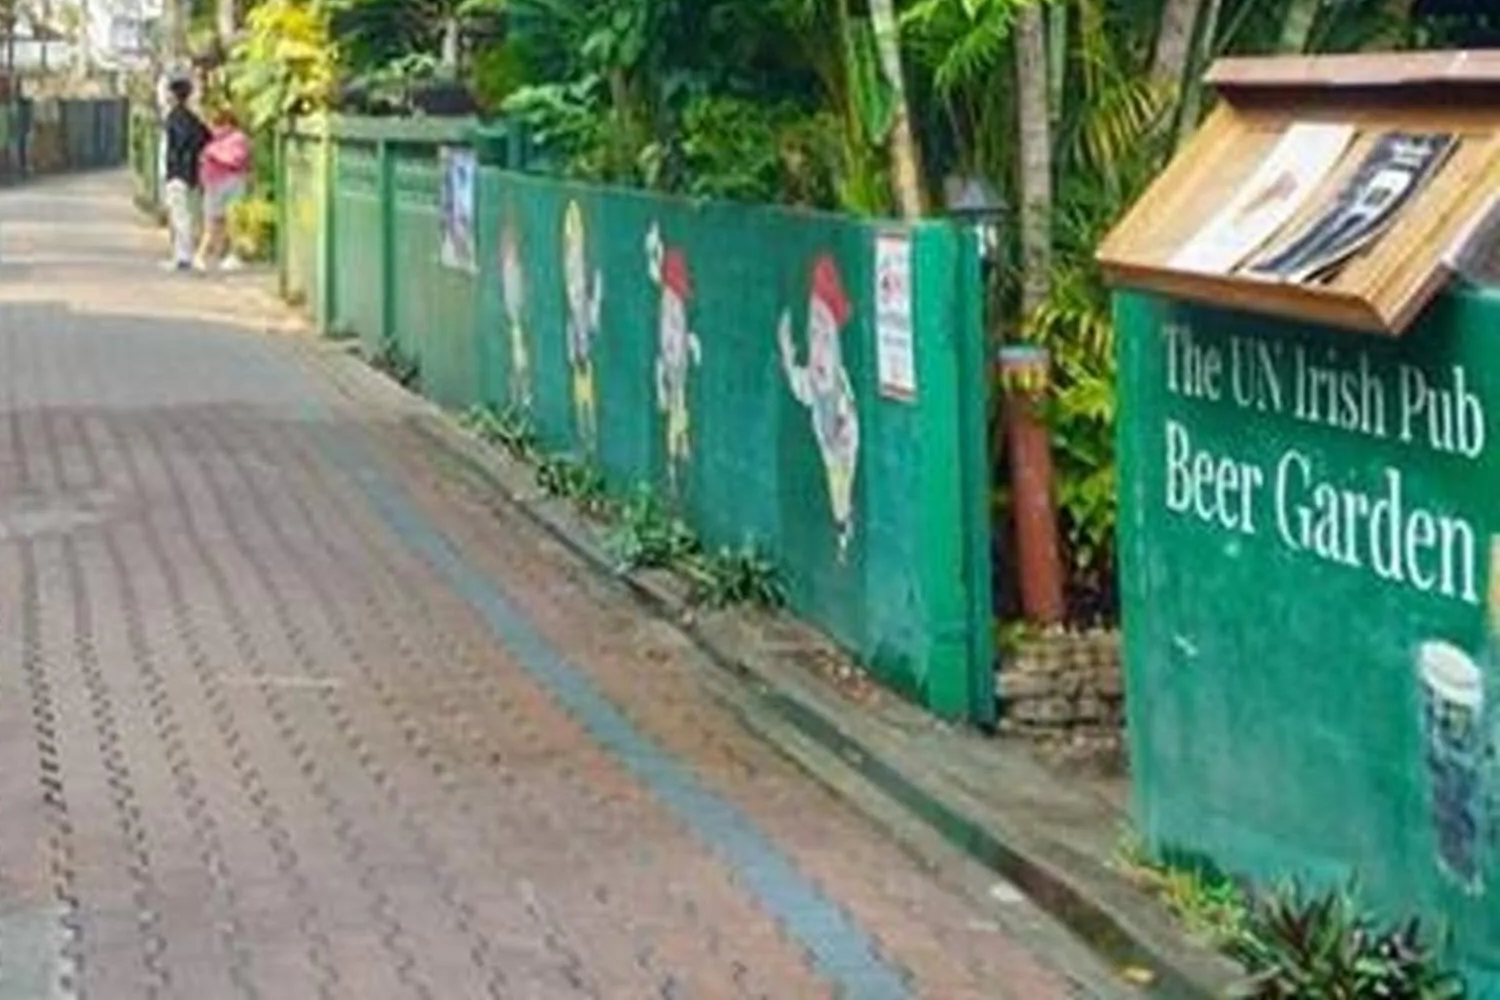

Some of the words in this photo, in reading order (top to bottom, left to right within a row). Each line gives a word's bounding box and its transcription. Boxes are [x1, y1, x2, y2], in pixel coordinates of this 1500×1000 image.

[1165, 324, 1221, 401] The
[1230, 336, 1285, 413] UN
[1295, 348, 1387, 437] Irish
[1400, 364, 1485, 459] Pub
[1164, 420, 1263, 534] Beer
[1275, 450, 1479, 603] Garden
